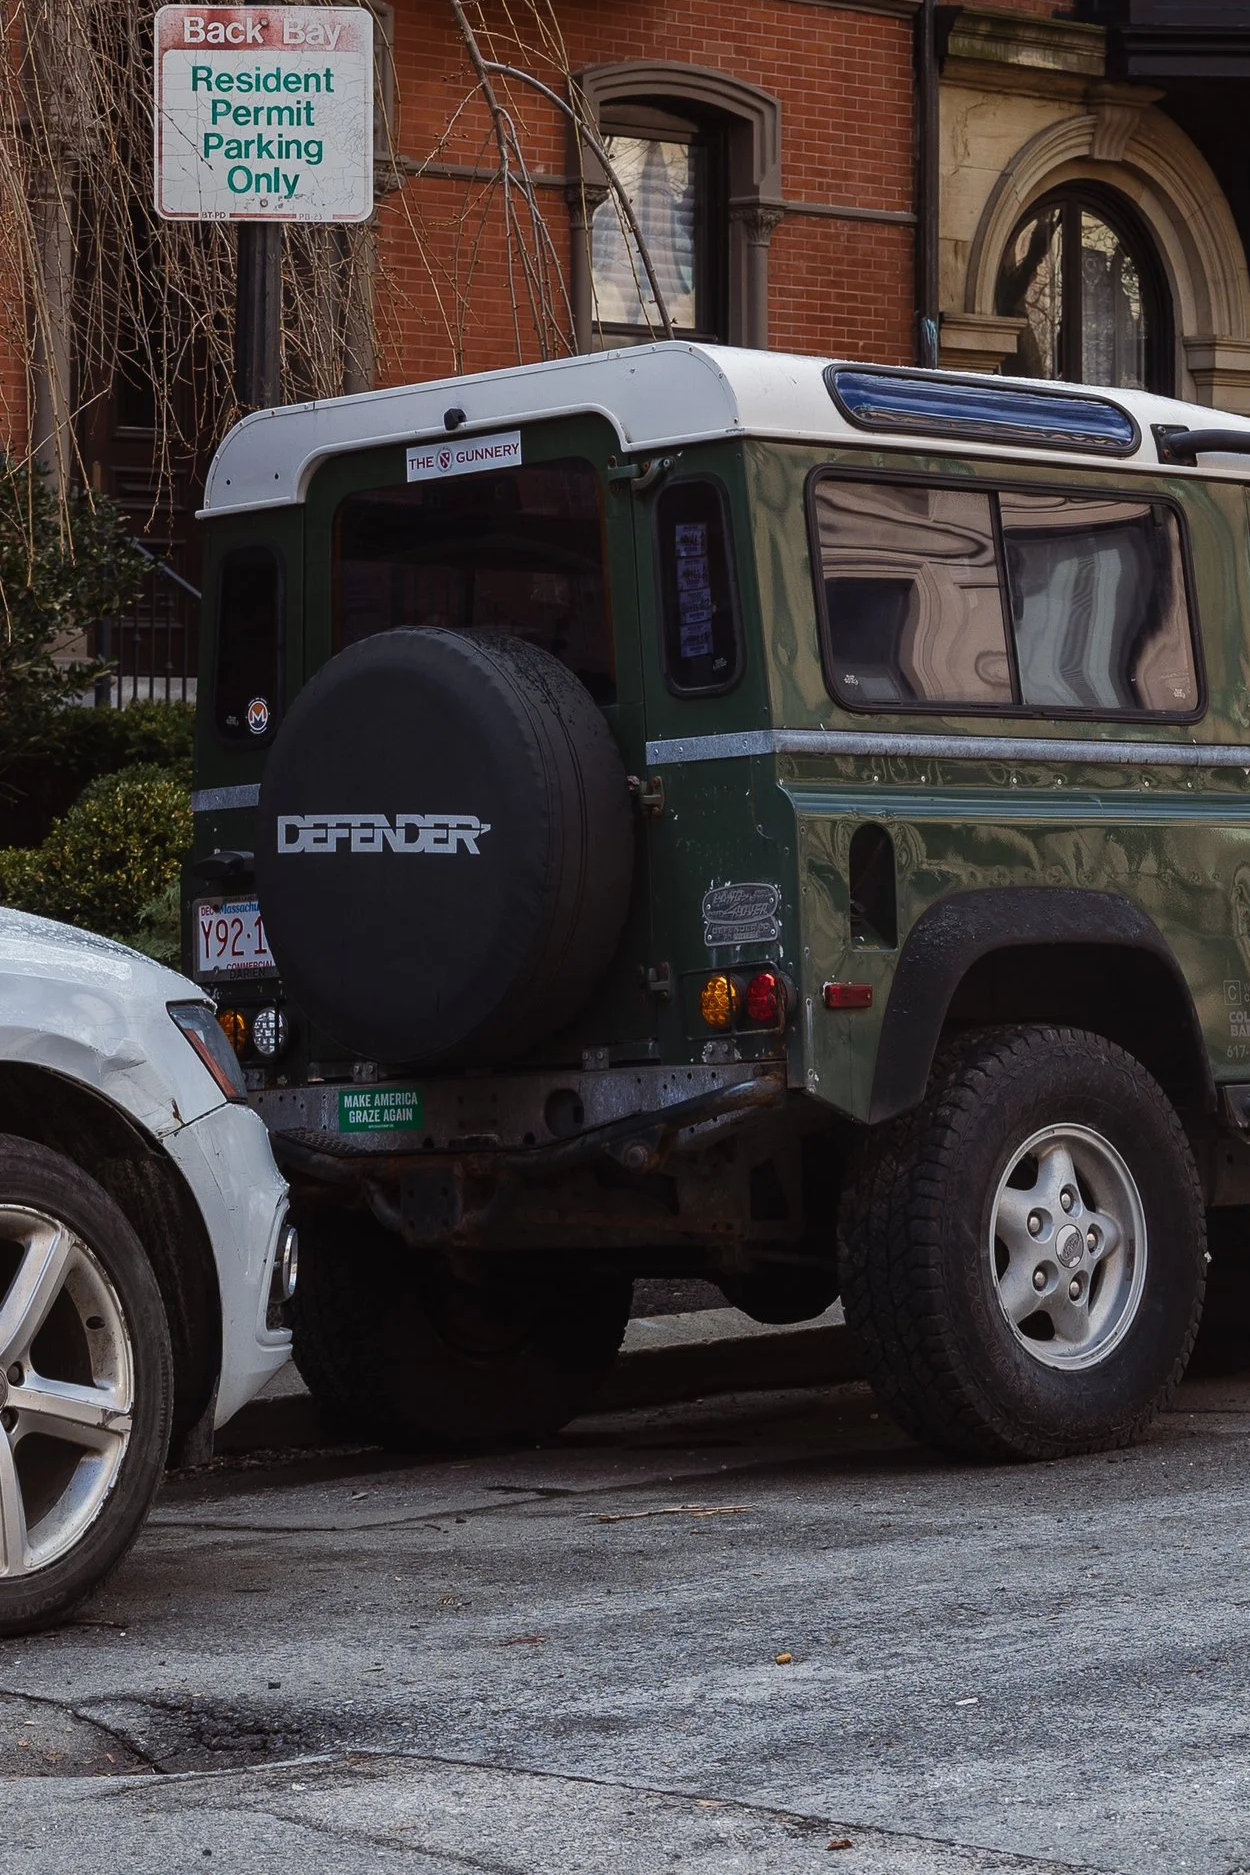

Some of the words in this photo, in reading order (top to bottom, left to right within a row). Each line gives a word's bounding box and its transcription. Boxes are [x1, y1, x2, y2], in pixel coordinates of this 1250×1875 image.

[182, 16, 265, 43] Back
[282, 17, 343, 50] Bay
[191, 65, 334, 93] Resident
[211, 99, 315, 126] Permit
[203, 132, 323, 165] Parking
[227, 165, 300, 200] Only
[408, 456, 435, 471] THE
[456, 443, 520, 463] GUNNERY
[277, 813, 491, 854] DEFENDER
[201, 906, 214, 916] DEC
[220, 901, 260, 914] Massachu
[344, 1094, 371, 1108] MAKE
[374, 1092, 418, 1106] AMERICA
[349, 1109, 381, 1123] GRAZE
[383, 1108, 413, 1122] AGAIN
